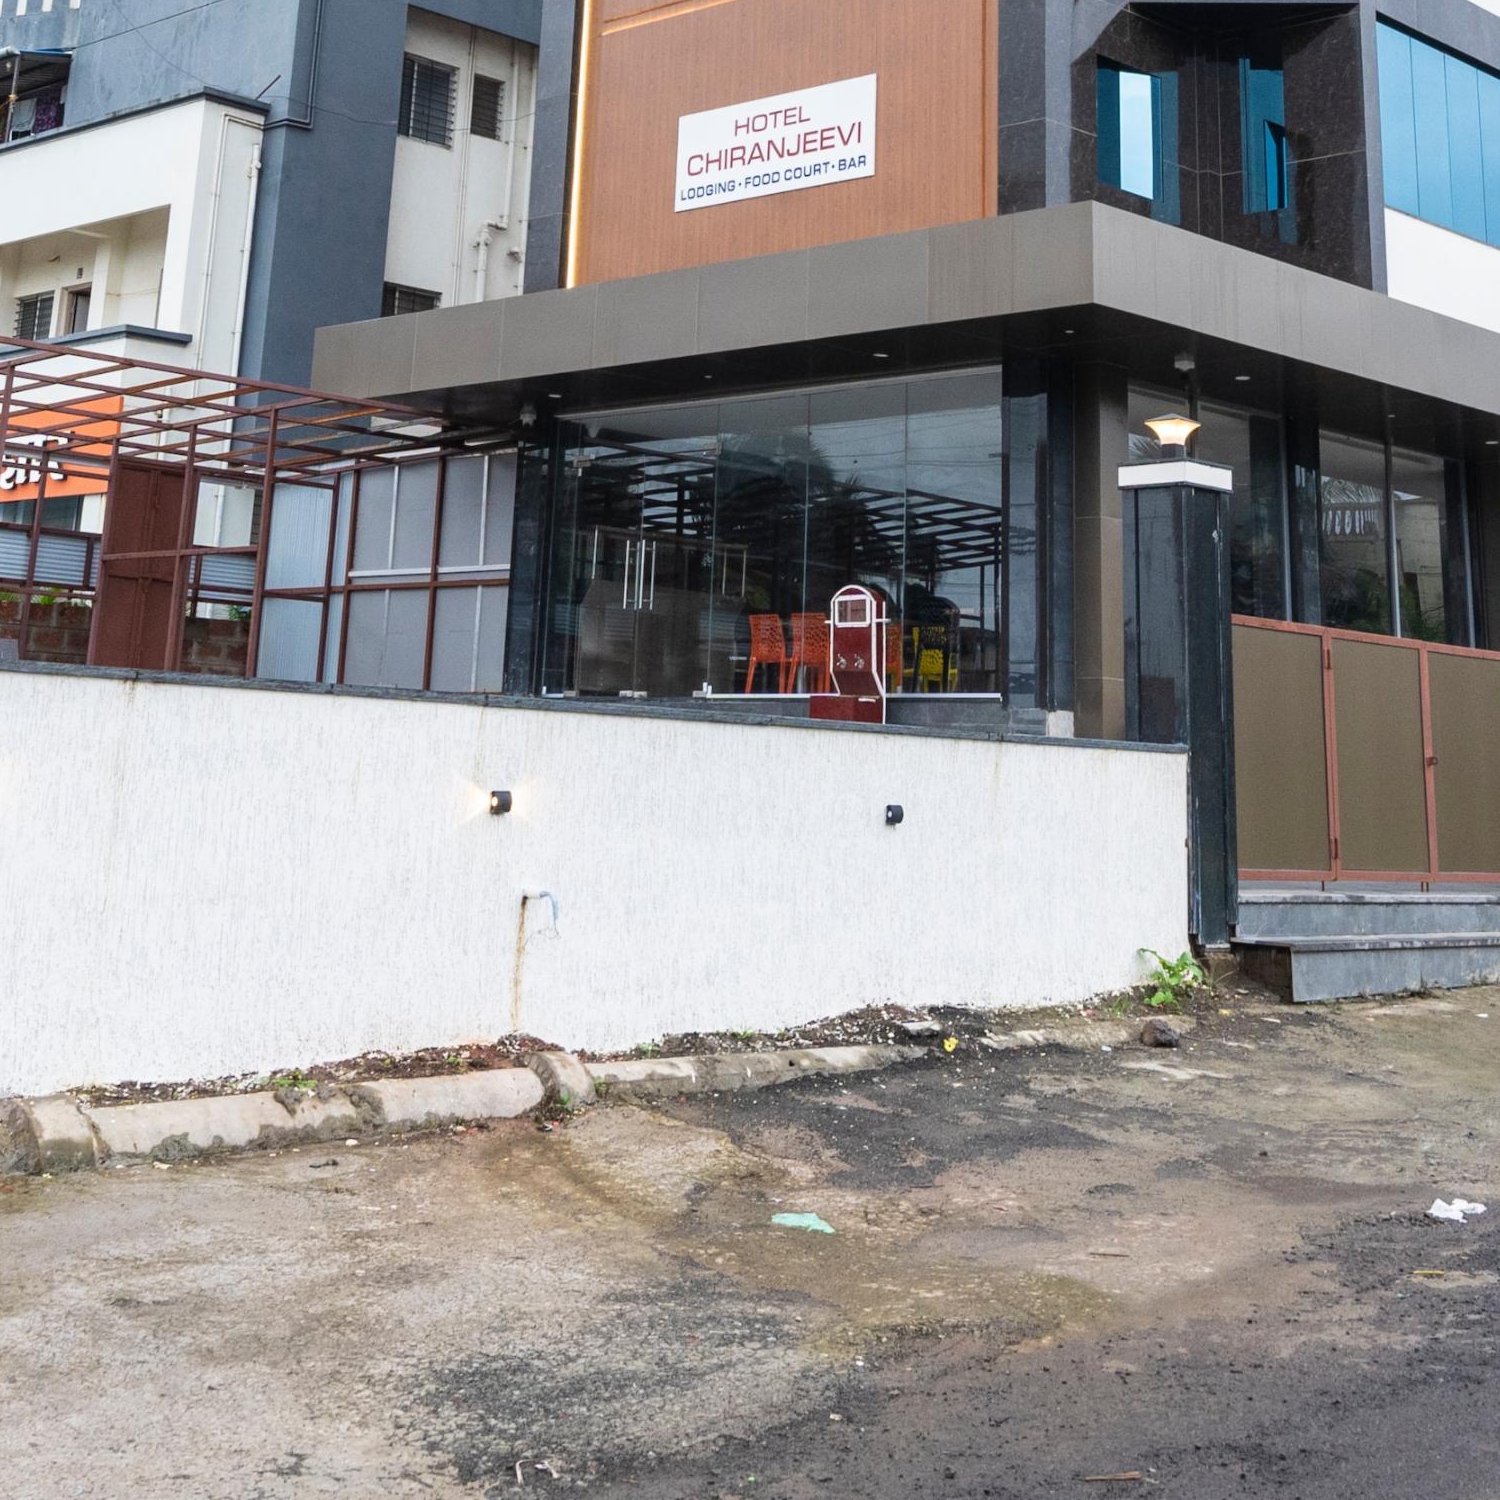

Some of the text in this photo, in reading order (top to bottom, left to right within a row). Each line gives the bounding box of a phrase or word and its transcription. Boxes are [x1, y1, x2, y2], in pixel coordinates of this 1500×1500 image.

[734, 105, 811, 136] HOTEL
[687, 121, 862, 177] CHIRANJEEVI
[680, 155, 867, 201] LODGING FOOD COURT BAR
